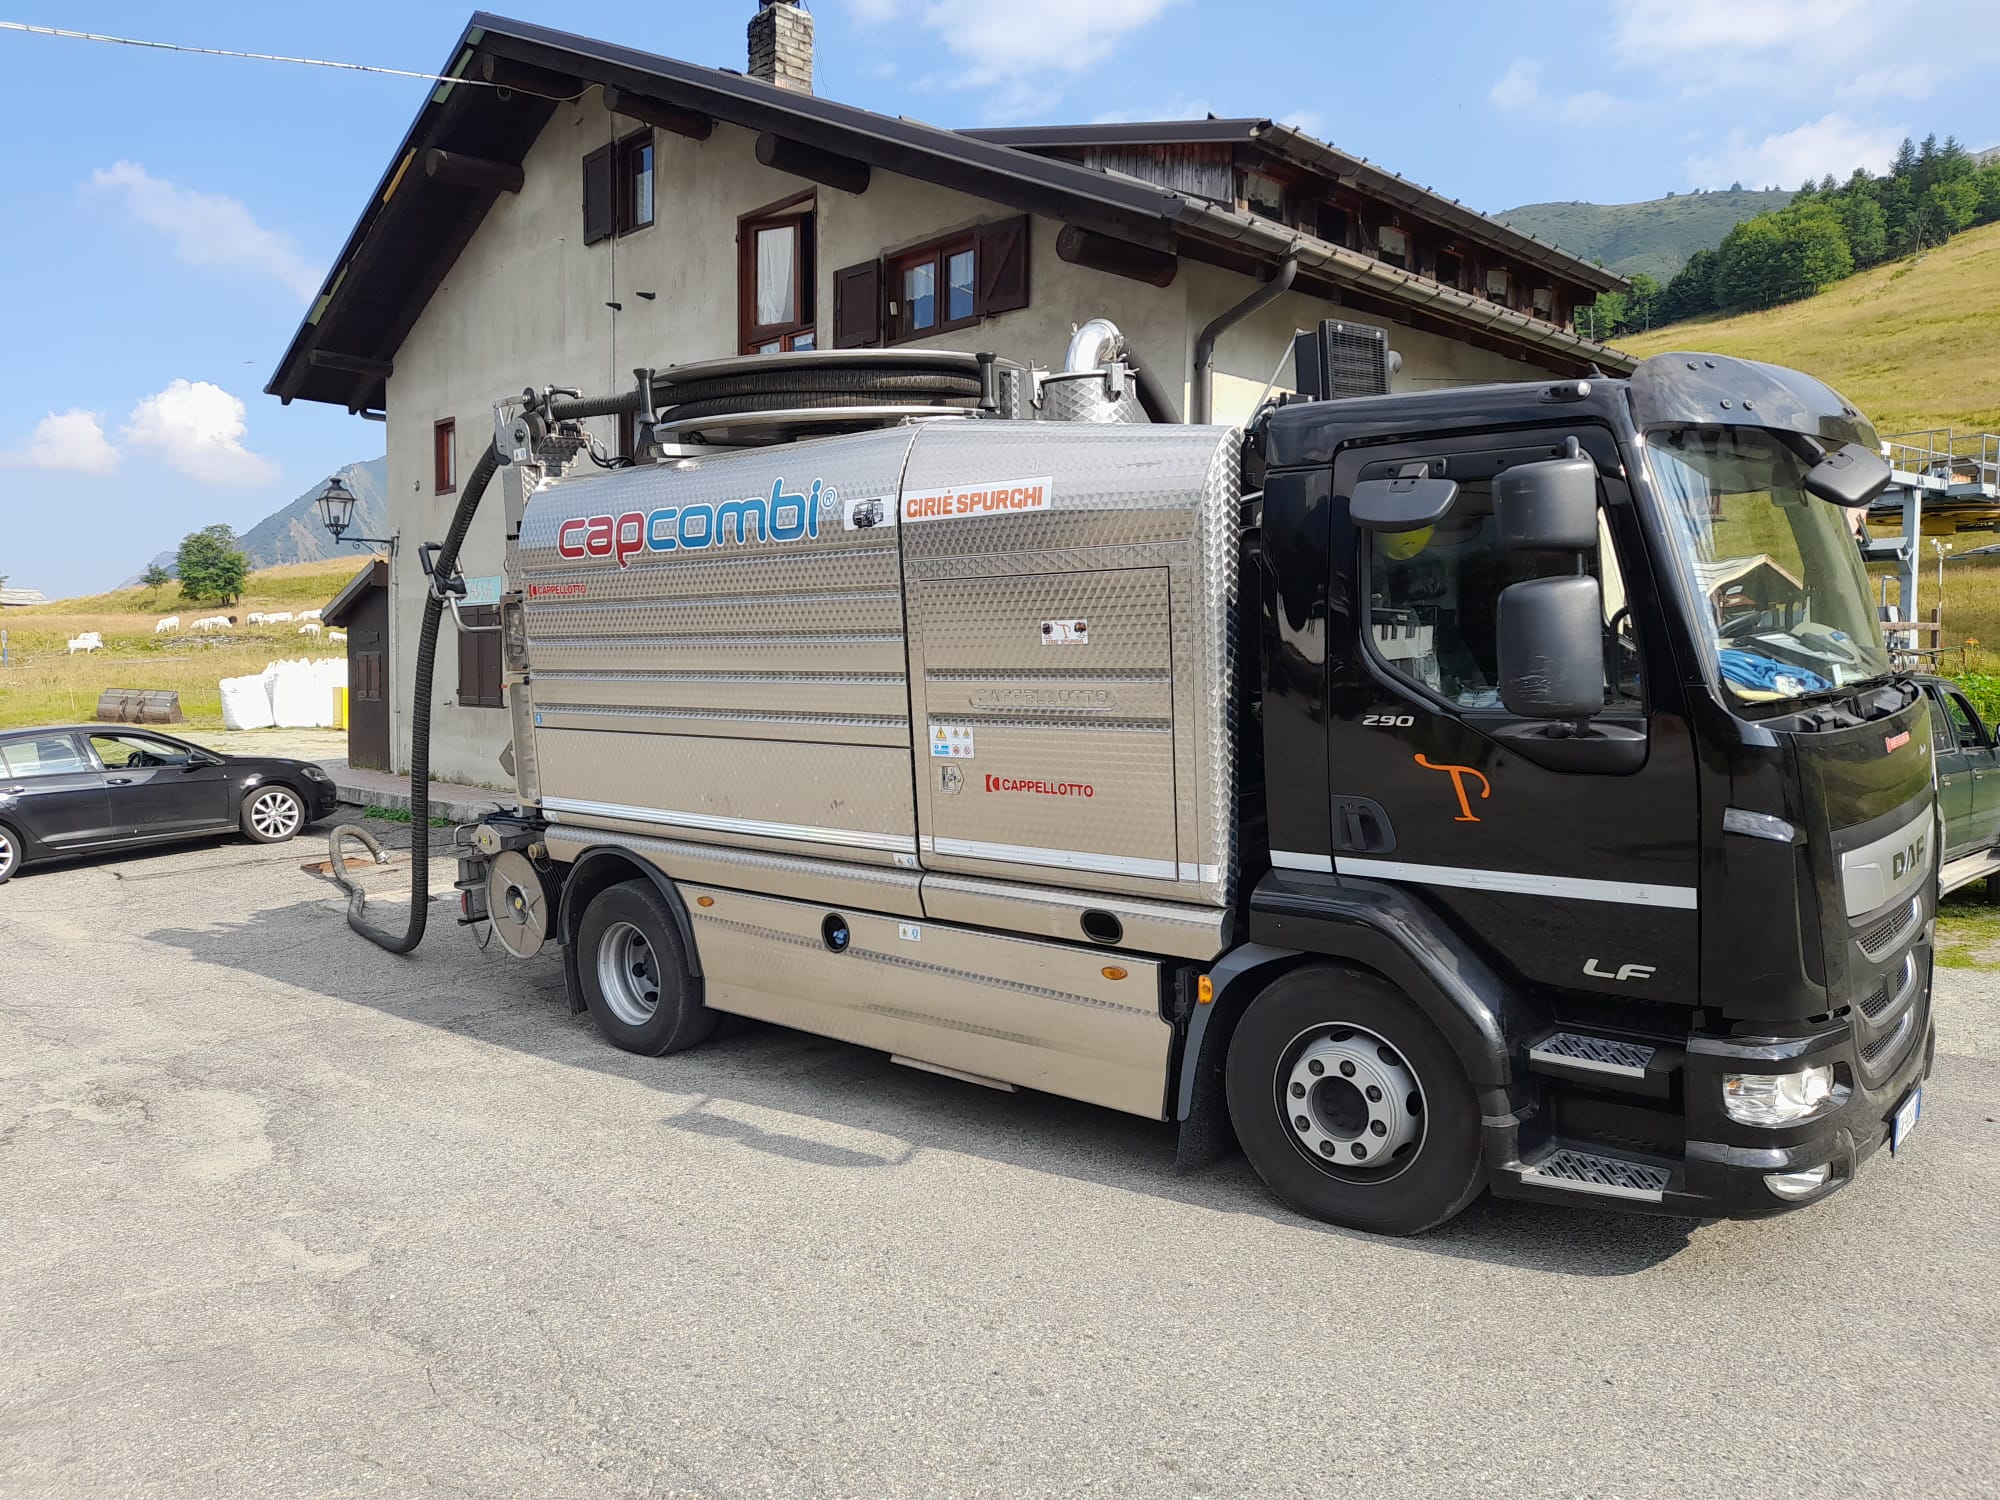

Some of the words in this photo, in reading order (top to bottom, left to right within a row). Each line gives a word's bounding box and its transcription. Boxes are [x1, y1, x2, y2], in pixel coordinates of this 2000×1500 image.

[956, 486, 1043, 514] SPURGHI
[538, 584, 587, 595] CAPPELLOTTO
[1361, 714, 1415, 728] 290
[1001, 777, 1094, 798] CAPPELLOTTO
[1893, 834, 1925, 881] DAF
[1582, 957, 1657, 981] LF
